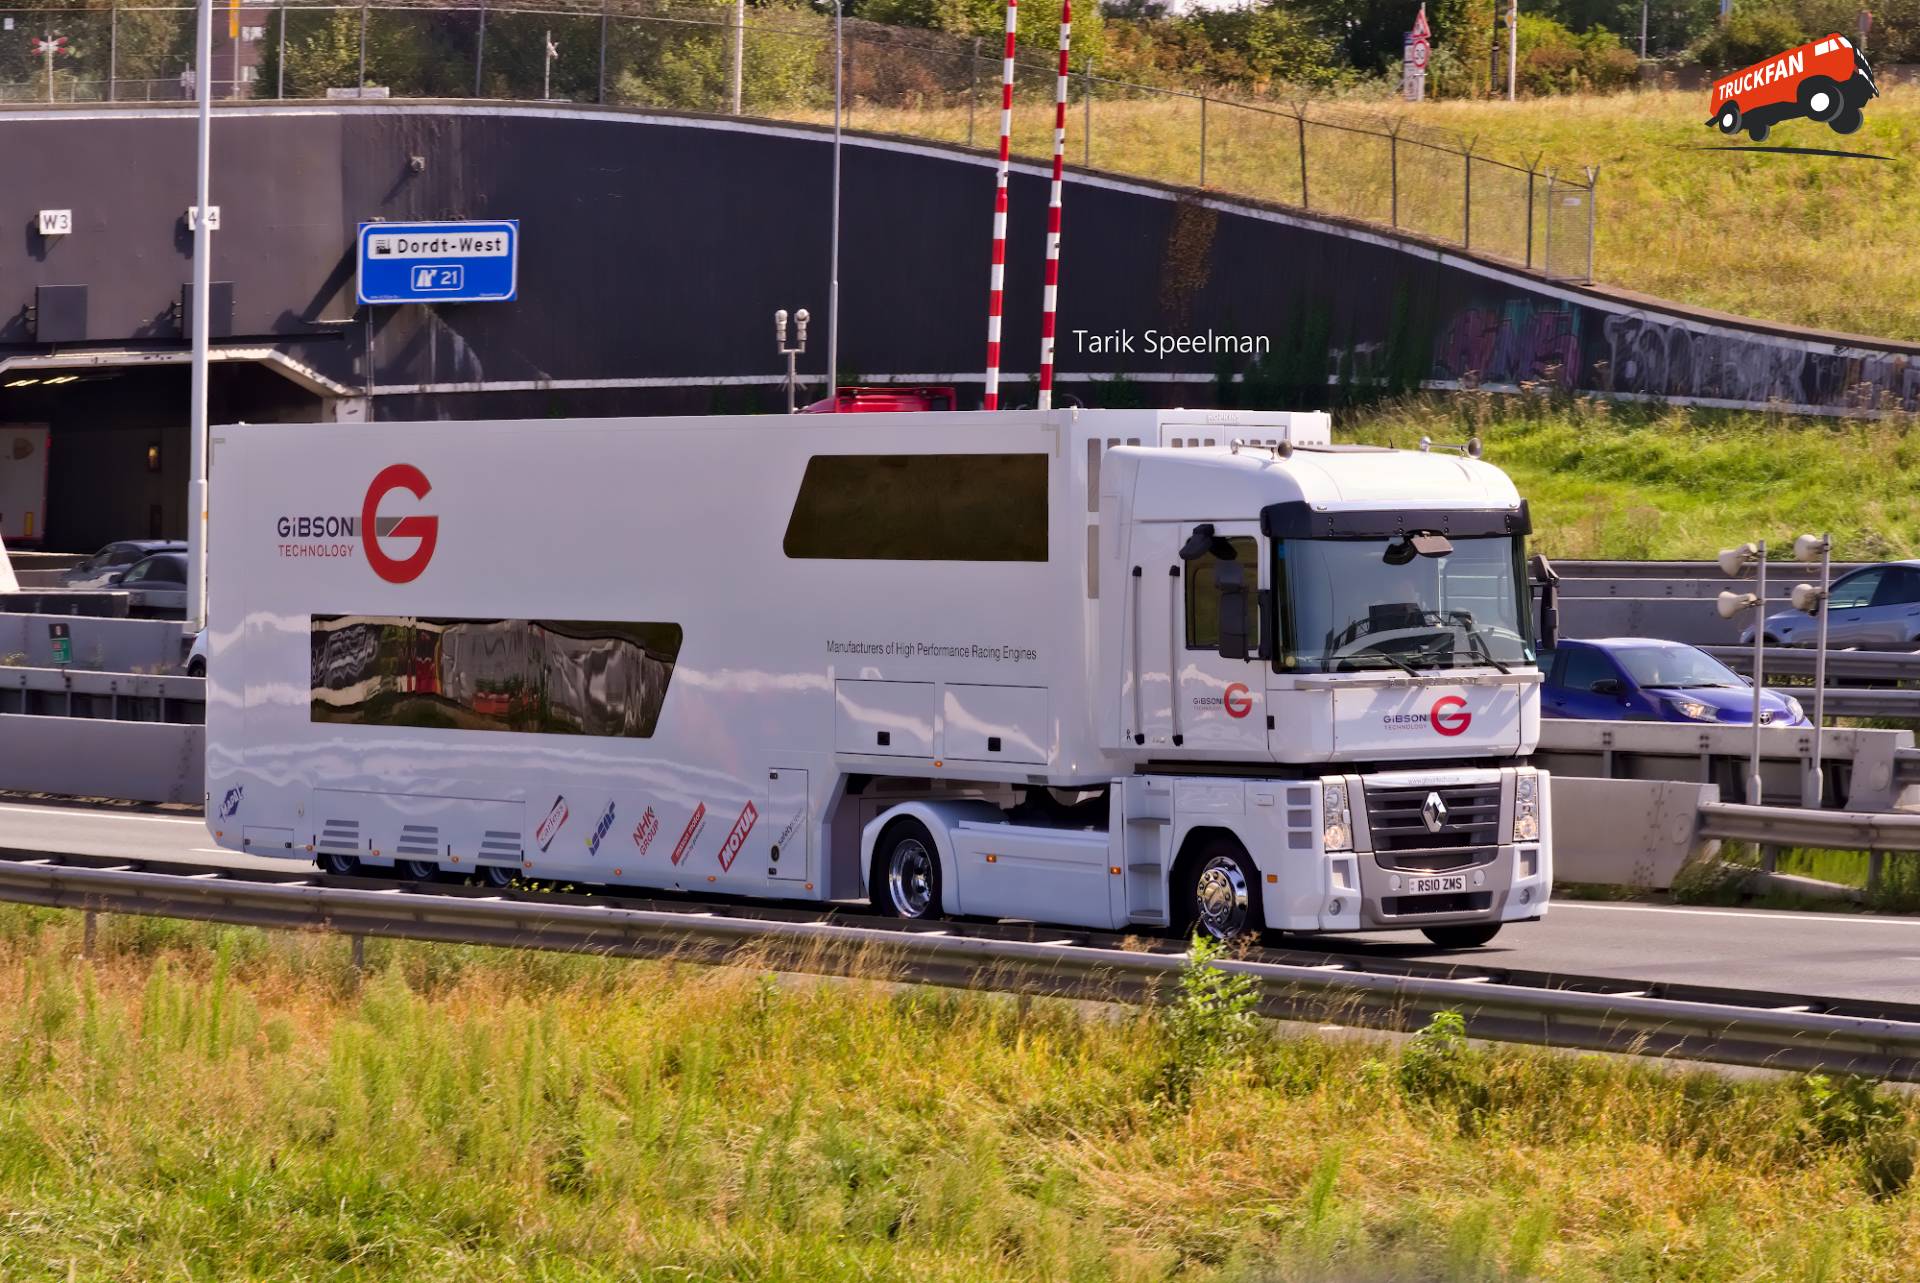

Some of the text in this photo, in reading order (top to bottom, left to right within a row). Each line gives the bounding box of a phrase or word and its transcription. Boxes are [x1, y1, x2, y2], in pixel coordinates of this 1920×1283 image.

[43, 214, 69, 230] W3
[397, 237, 502, 254] Dordt-West
[440, 270, 458, 286] 21
[278, 545, 354, 557] TECHNOLOGY
[826, 640, 1037, 662] Manufacturers of High Performance Racing Engines
[632, 805, 656, 847] NHK
[639, 818, 660, 856] GROUP
[720, 804, 757, 870] MOTUL
[1417, 877, 1462, 892] RS10 ZMS
